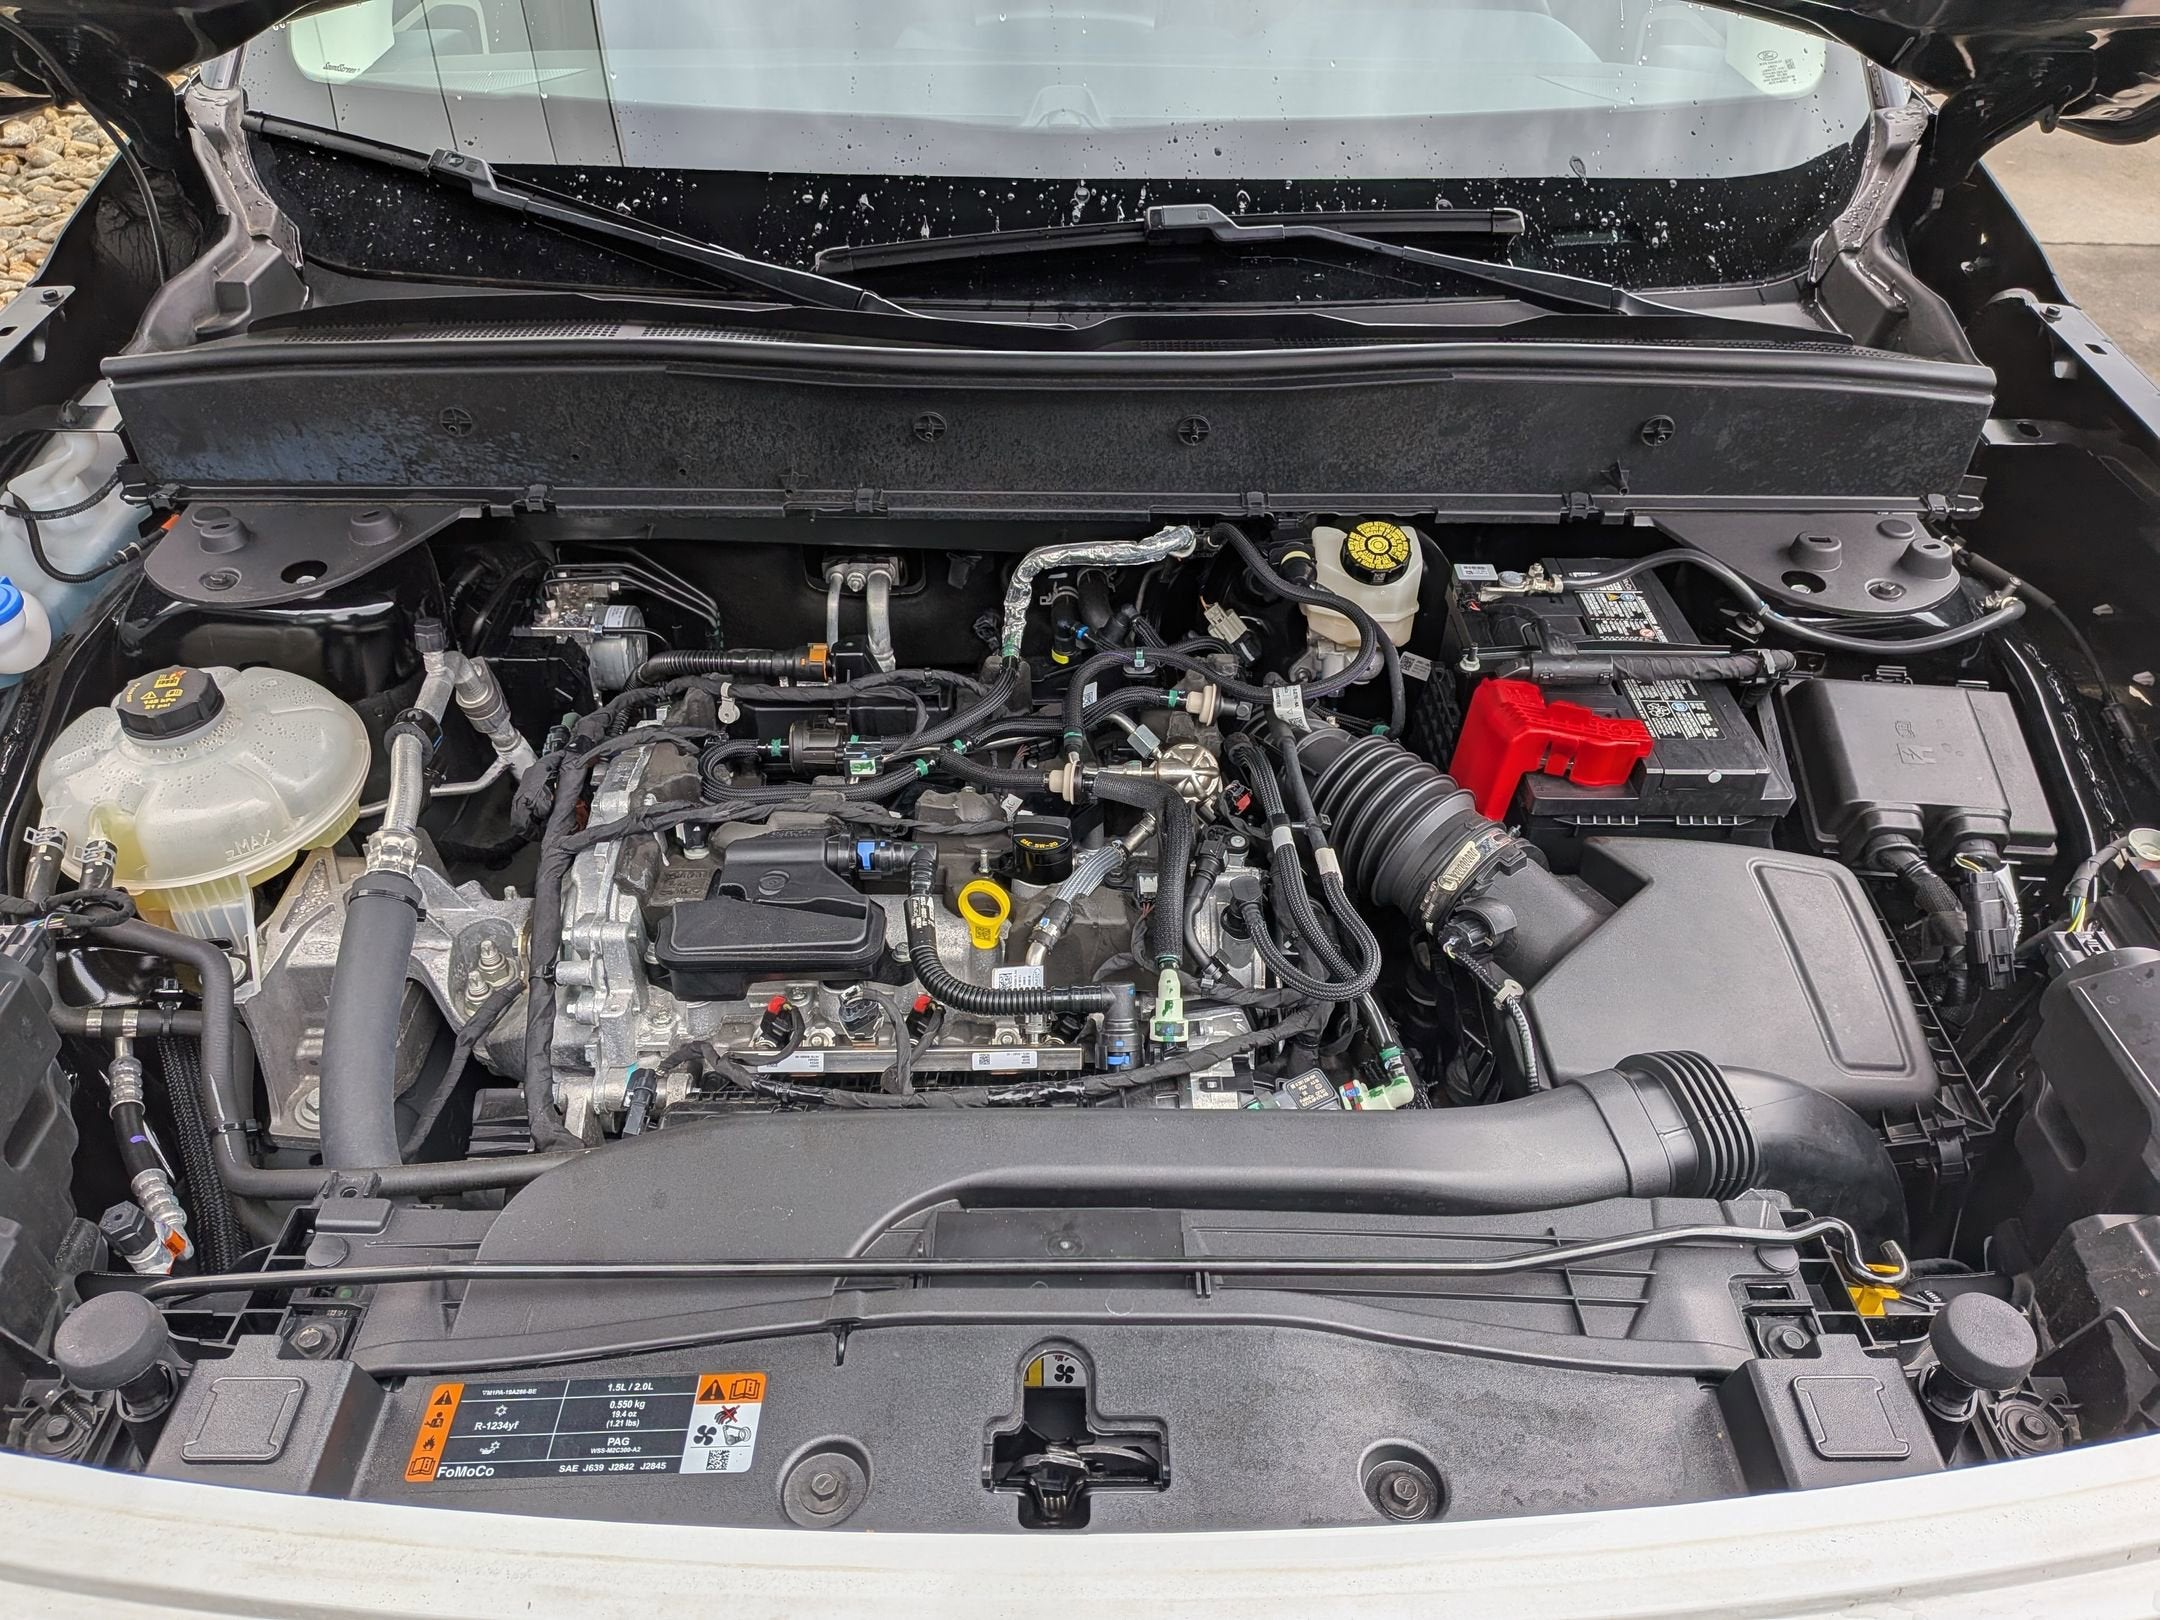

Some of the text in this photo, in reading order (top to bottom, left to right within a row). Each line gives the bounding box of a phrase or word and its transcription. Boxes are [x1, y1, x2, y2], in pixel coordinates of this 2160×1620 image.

[607, 1383, 627, 1392] 1.5L
[633, 1382, 654, 1391] 2.0L
[609, 1399, 646, 1410] 0.550 kg
[611, 1410, 627, 1418] 19.4
[474, 1420, 520, 1432] R-1234yf
[607, 1437, 630, 1446] PAG
[436, 1465, 495, 1478] FoMoCo
[558, 1462, 667, 1473] SAE J639 J2842 J2845
